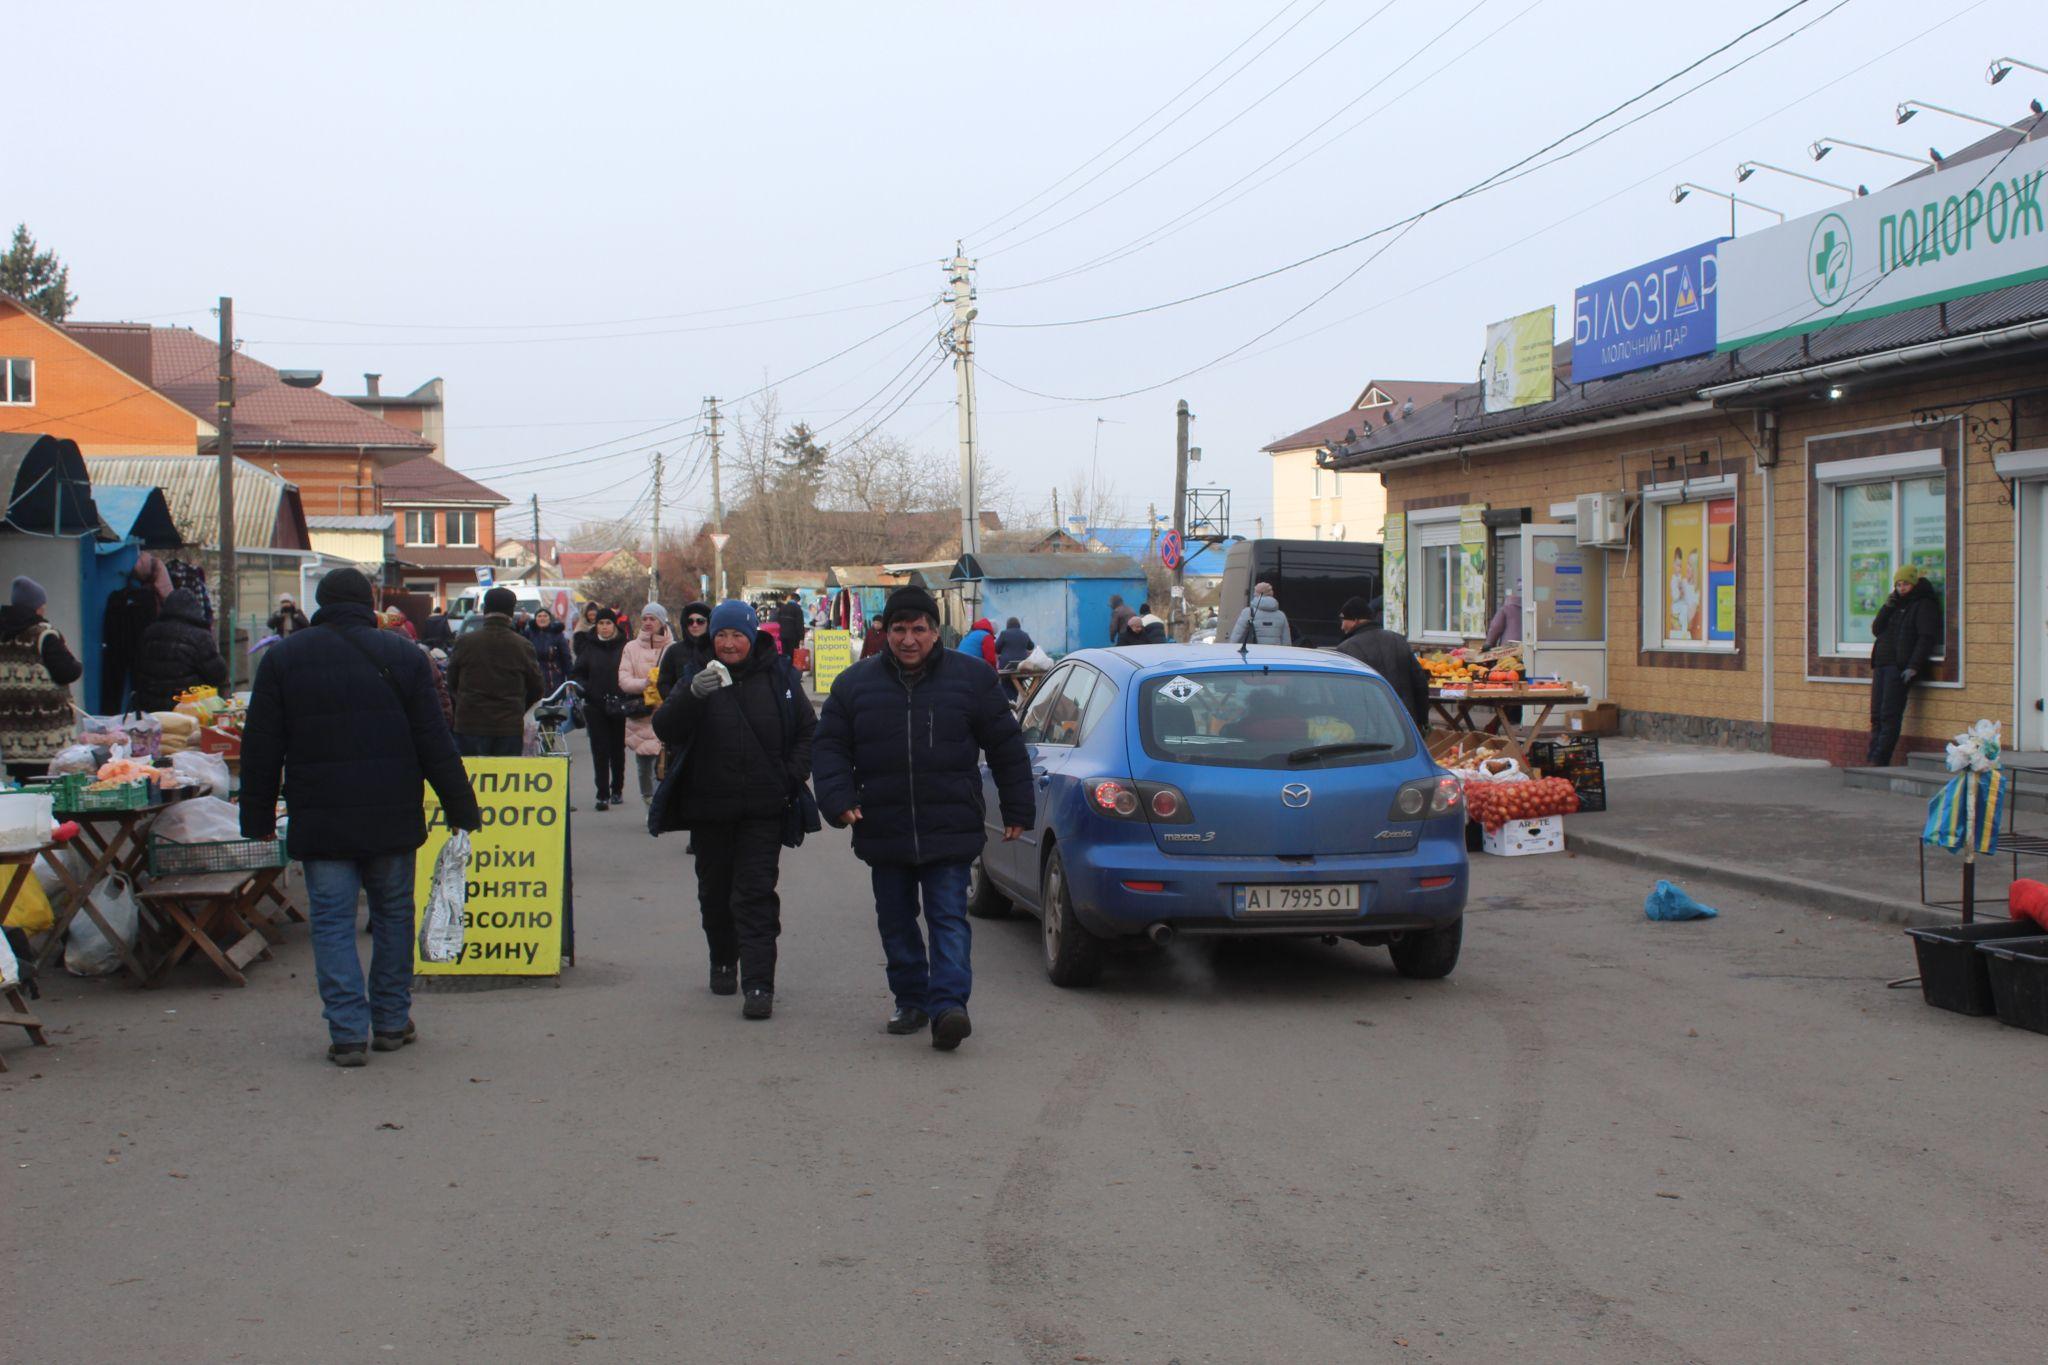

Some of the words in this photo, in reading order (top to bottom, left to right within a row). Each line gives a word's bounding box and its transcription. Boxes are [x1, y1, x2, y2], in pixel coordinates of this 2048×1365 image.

[1602, 328, 1662, 365] МОЛОЧНИЙ
[1663, 325, 1688, 353] ДАР
[428, 805, 557, 832] дрого
[1202, 831, 1216, 841] 3
[464, 881, 547, 904] рнята
[1280, 889, 1323, 907] 7995
[462, 911, 552, 929] асолю
[456, 942, 539, 964] узину
